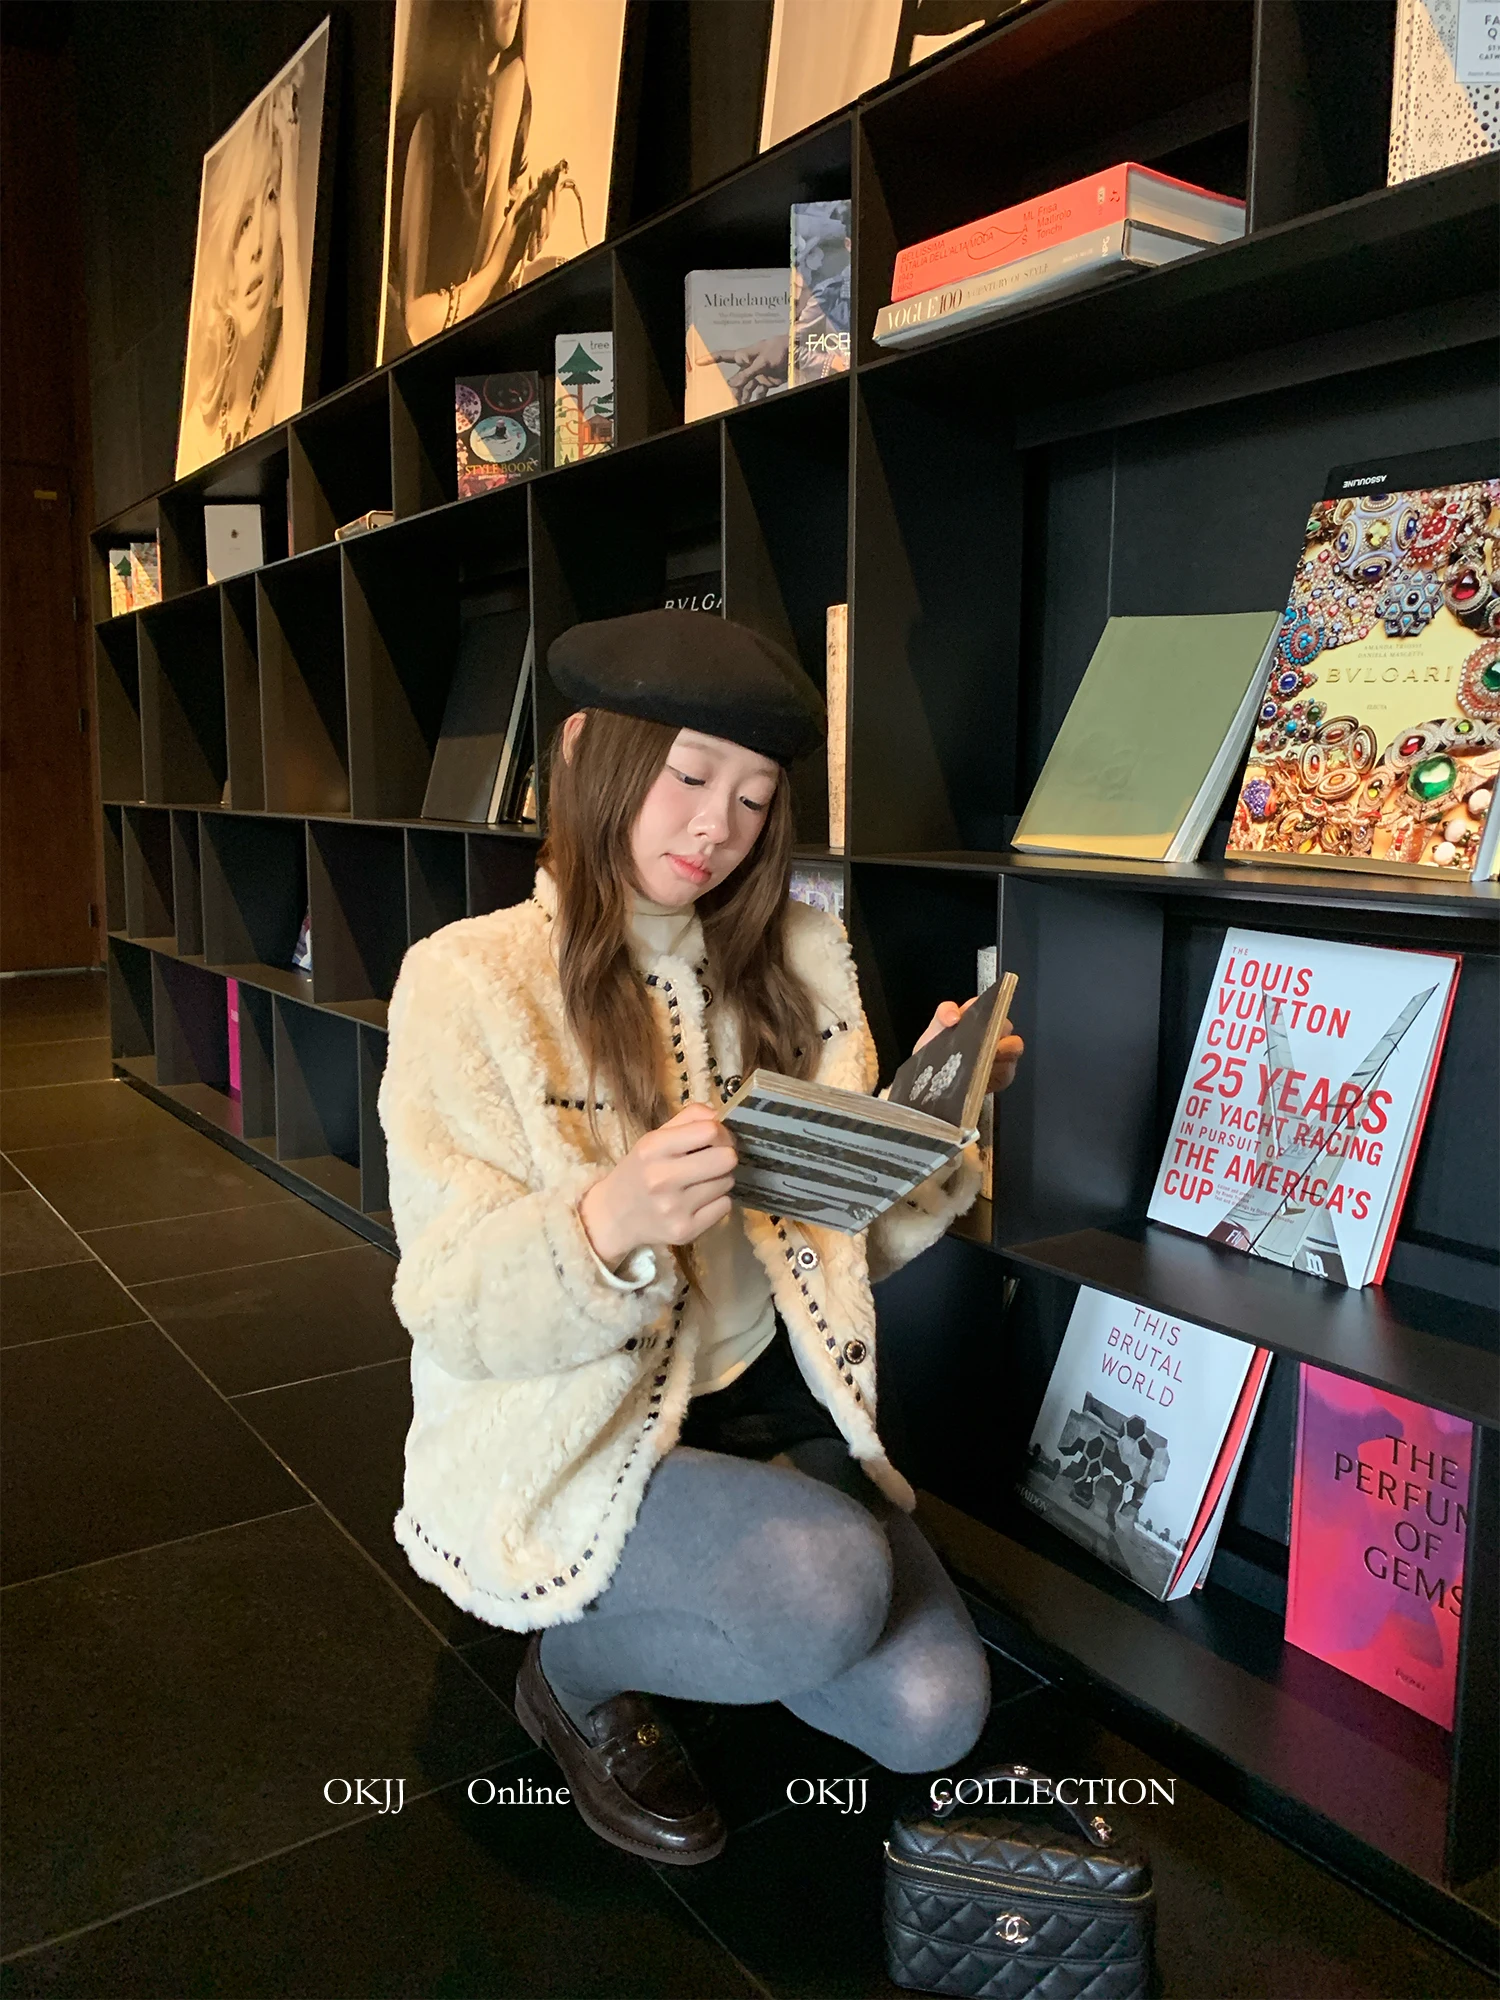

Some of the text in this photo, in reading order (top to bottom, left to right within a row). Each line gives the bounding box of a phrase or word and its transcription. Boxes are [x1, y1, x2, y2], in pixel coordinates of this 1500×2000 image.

[1487, 27, 1498, 41] Q
[901, 240, 945, 263] BELLISSIMA
[970, 232, 994, 248] MODA
[590, 340, 610, 350] tree
[465, 461, 534, 476] STYLE BOOK
[1342, 474, 1388, 489] ASSOULINE
[1325, 666, 1454, 684] BVLGARI
[1232, 946, 1249, 956] THE
[1223, 956, 1314, 997] LOUIS
[1218, 987, 1352, 1039] VUITTON
[1206, 1018, 1266, 1054] CUP
[1193, 1052, 1393, 1135] 25 YEARS
[1180, 1121, 1285, 1160] IN PURSUIT OF
[1185, 1095, 1384, 1167] OF YACHT RACING
[1163, 1168, 1214, 1204] CUP
[1173, 1137, 1372, 1220] THE AMERICA'S
[1133, 1306, 1181, 1347] THIS
[1107, 1326, 1183, 1384] BRUTAL
[1101, 1353, 1174, 1407] WORLD
[1385, 1434, 1459, 1490] THE
[1394, 1520, 1443, 1561] OF
[1363, 1545, 1462, 1618] GEMS
